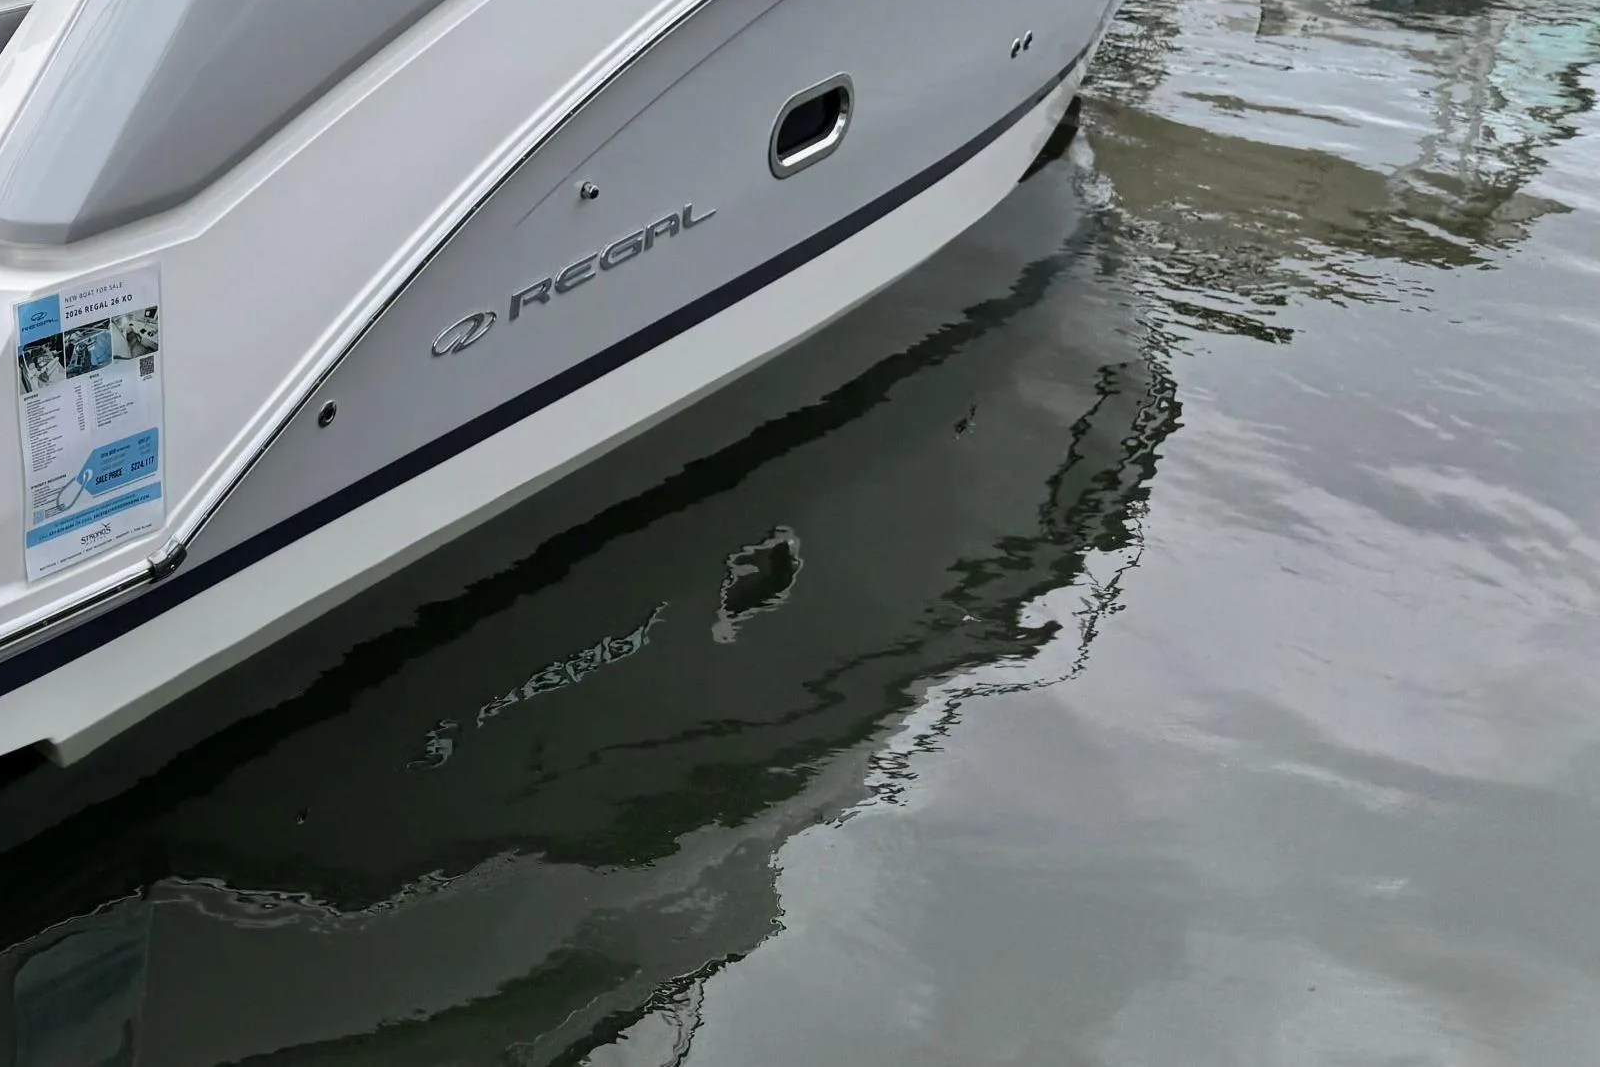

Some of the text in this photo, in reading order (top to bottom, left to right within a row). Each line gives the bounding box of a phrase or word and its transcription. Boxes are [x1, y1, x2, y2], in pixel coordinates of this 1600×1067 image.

[509, 203, 717, 322] REGAL
[64, 294, 78, 303] NEW
[79, 289, 94, 299] BOAT
[65, 294, 133, 319] 2026 REGAL 26 XO
[95, 473, 108, 486] SALE
